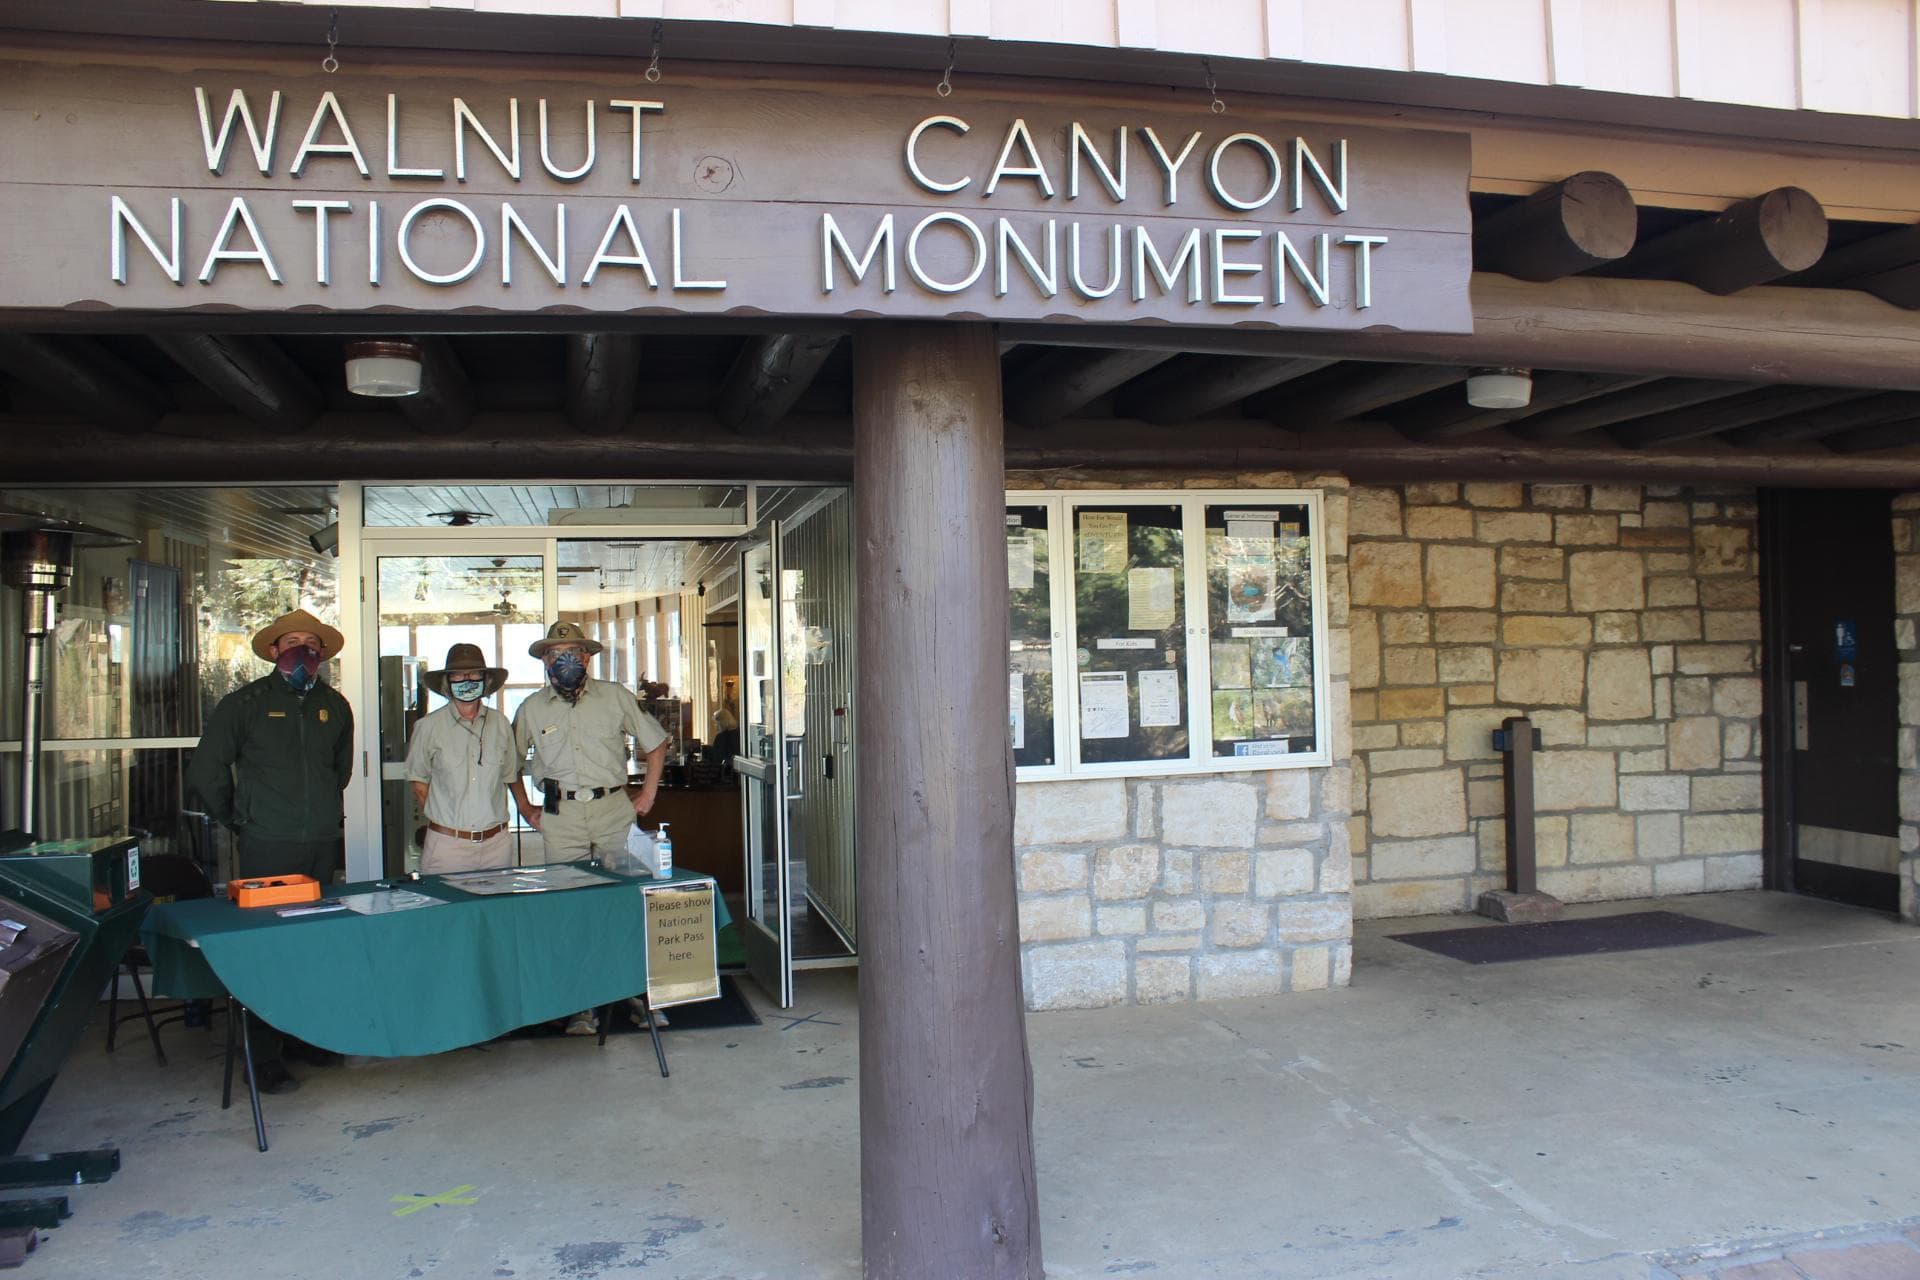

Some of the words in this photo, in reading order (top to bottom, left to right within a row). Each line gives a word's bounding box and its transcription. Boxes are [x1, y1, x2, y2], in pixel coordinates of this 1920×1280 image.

[195, 87, 665, 184] WALNUT
[903, 115, 1349, 214] CANYON
[110, 195, 728, 292] NATIONAL
[819, 211, 1388, 310] MONUMENT
[649, 901, 681, 912] Please
[684, 897, 711, 908] show
[659, 914, 703, 928] National
[658, 934, 681, 946] Park
[684, 932, 705, 943] Pass
[669, 951, 695, 961] here.
